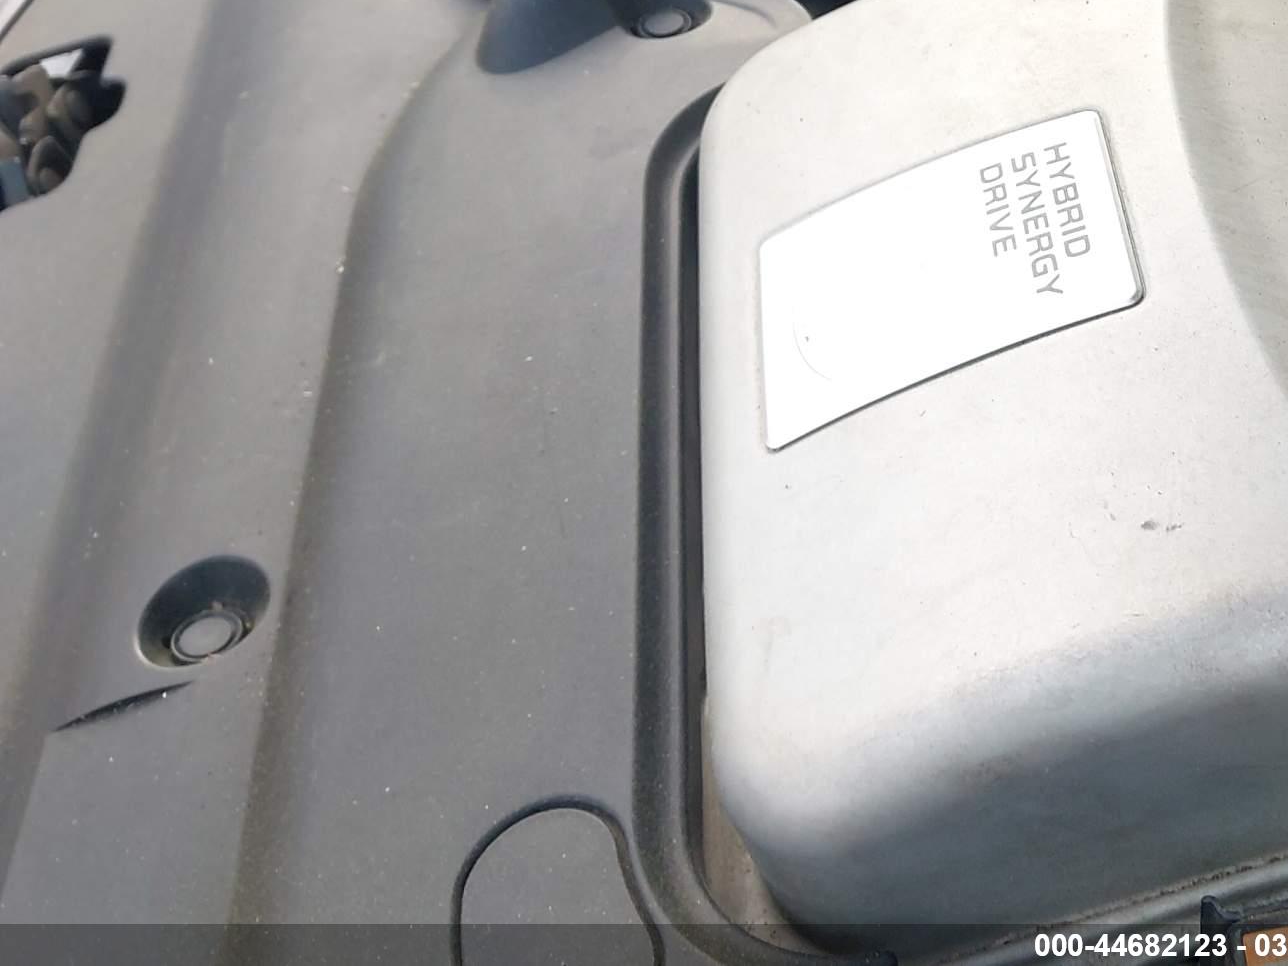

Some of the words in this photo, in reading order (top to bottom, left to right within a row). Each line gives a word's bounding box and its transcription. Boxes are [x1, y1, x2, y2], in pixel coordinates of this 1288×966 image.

[979, 162, 1017, 257] DRIVE
[1011, 152, 1064, 294] SYNERGY
[1044, 142, 1091, 258] HYBRID
